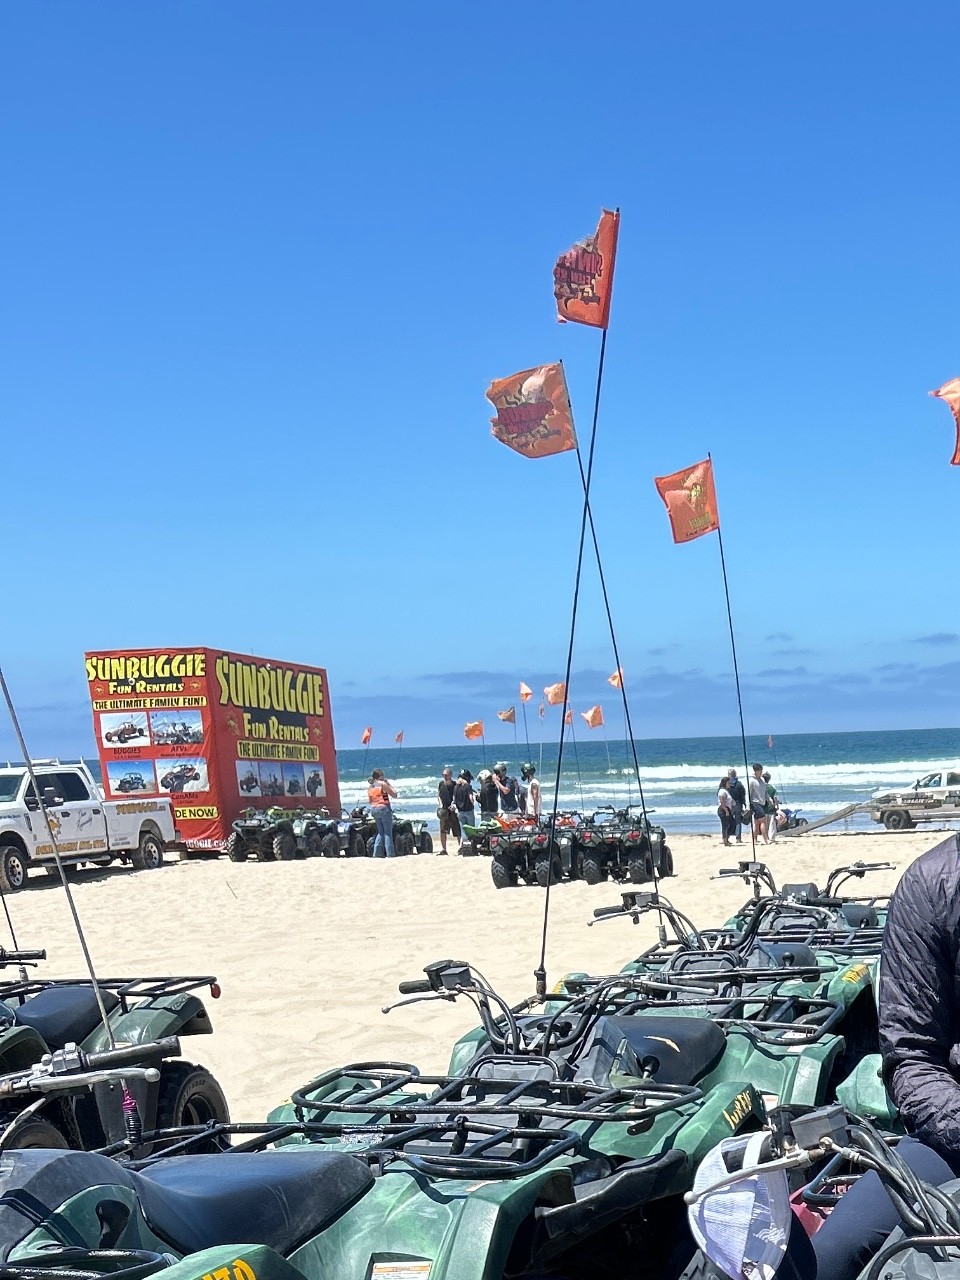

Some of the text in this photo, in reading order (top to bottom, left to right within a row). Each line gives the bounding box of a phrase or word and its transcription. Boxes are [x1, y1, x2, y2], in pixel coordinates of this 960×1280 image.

[86, 654, 206, 681] SUNBUGGIE
[109, 680, 185, 695] FUN RENTALS
[215, 655, 324, 715] SUNBUGGIE
[94, 696, 204, 709] THE ULTIMATE FAMILY FUN!
[243, 712, 309, 742] FUN RENTALS
[239, 741, 251, 757] THE
[252, 743, 280, 758] ULTIMATE
[175, 808, 215, 818] DE NOW
